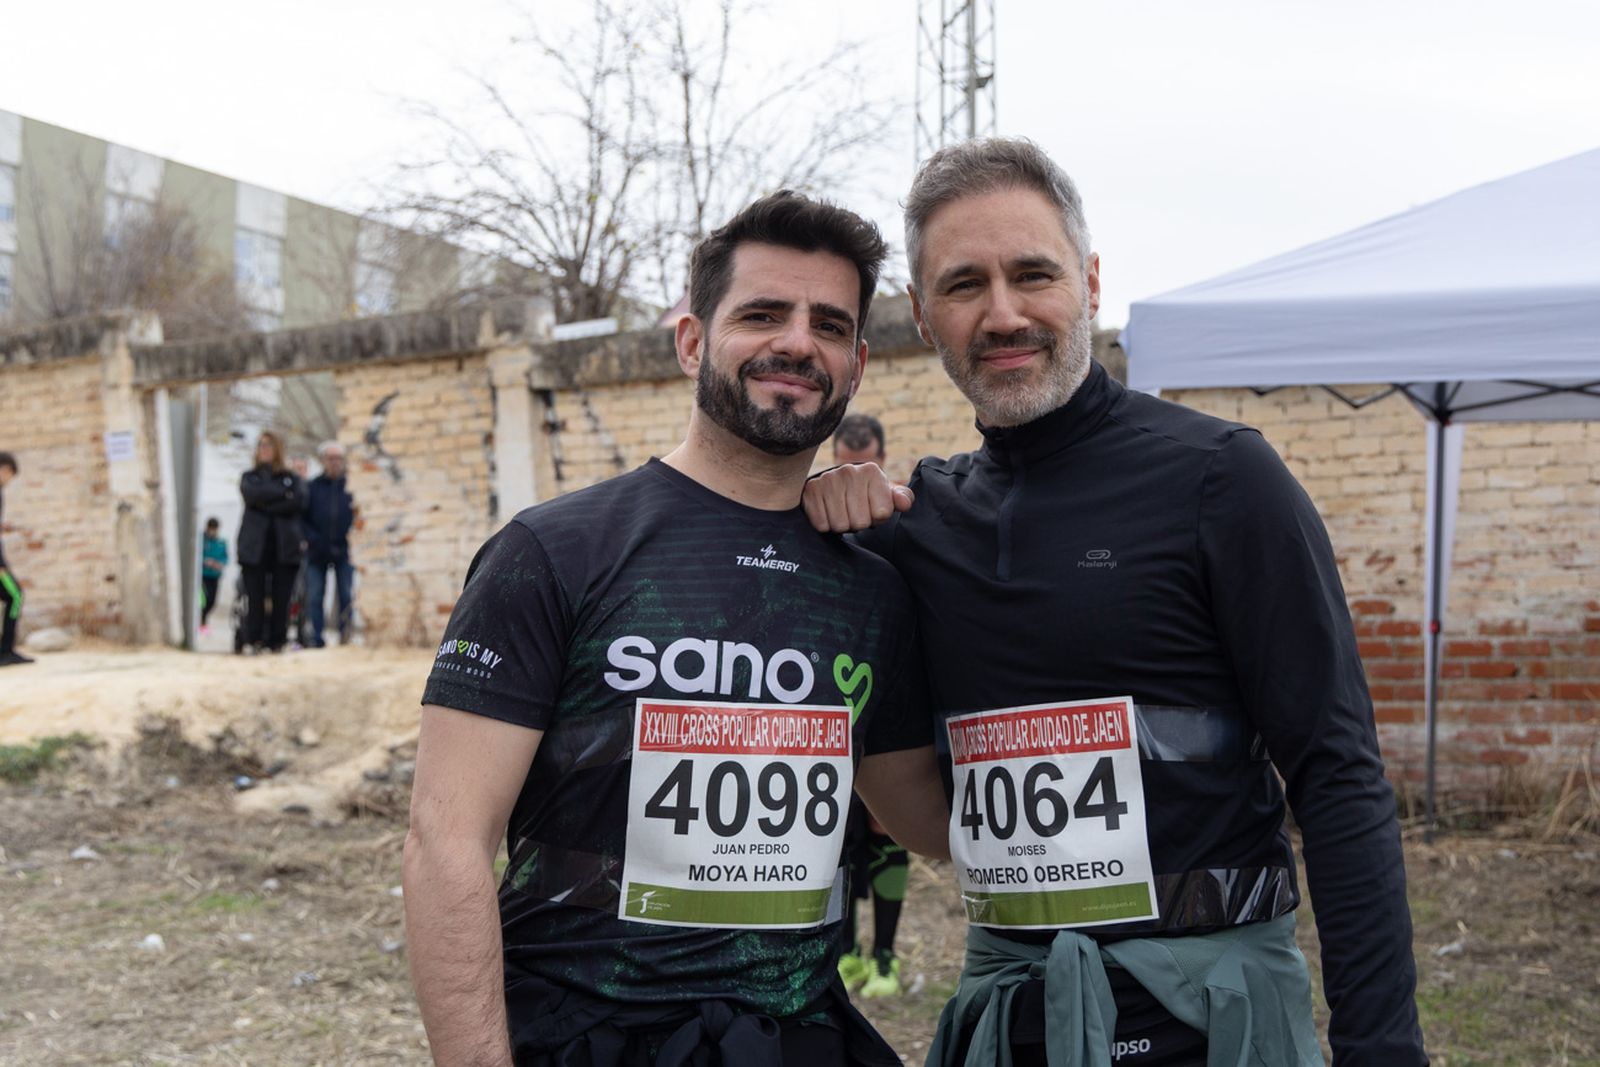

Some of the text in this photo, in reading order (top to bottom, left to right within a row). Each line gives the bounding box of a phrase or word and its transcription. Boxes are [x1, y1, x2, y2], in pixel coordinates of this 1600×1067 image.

[736, 555, 800, 573] TEAMERGY
[466, 642, 480, 658] IS
[480, 648, 502, 668] MY
[603, 635, 815, 704] sano
[643, 711, 847, 749] XXVIII CROSS POPULAR CIUDAD DE JAEN
[987, 718, 1030, 753] POPULAR
[1029, 714, 1071, 749] CIUDAD
[1073, 713, 1091, 745] DE
[1092, 710, 1124, 743] JAEN
[644, 759, 840, 837] 4098
[960, 756, 1128, 841] 4064
[712, 843, 790, 855] JUAN PEDRO
[1008, 844, 1047, 857] MOISES
[688, 864, 808, 882] MOYA HARO
[966, 859, 1124, 885] ROMERO OBRERO
